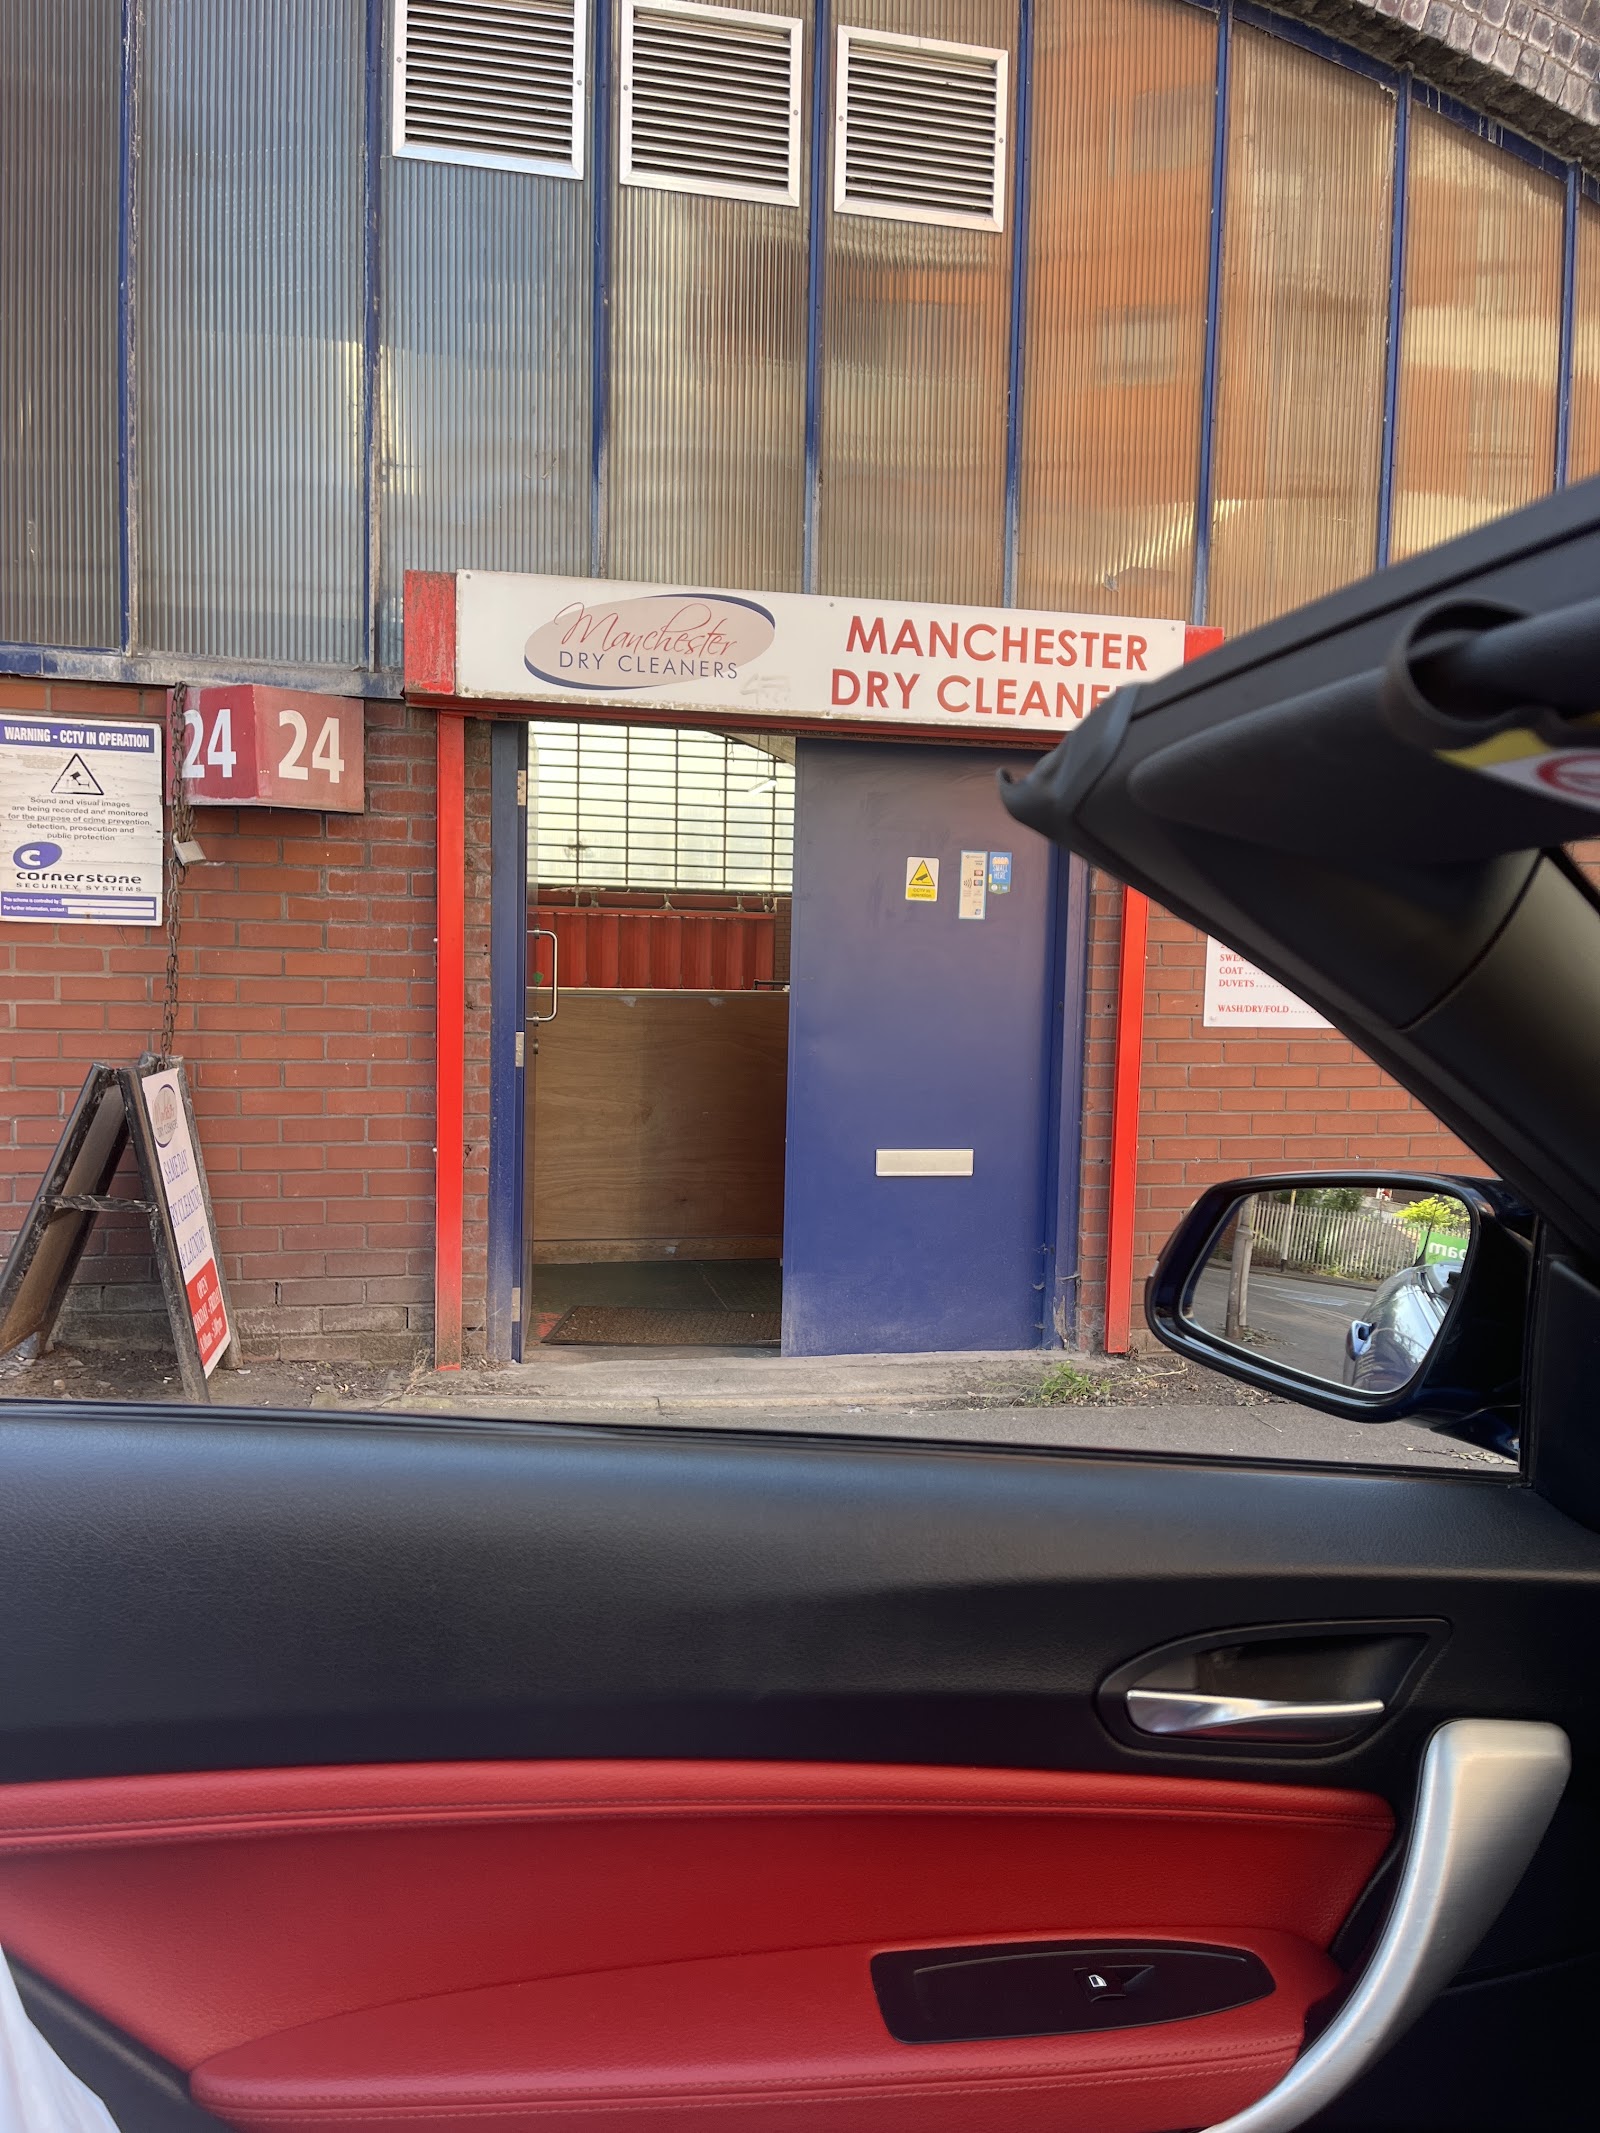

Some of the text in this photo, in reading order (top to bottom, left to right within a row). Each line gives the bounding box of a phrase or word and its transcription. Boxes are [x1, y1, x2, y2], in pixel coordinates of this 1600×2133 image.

[554, 602, 738, 657] Manchester
[846, 615, 1148, 671] MANCHESTER
[559, 651, 738, 679] DRY CLEANERS
[831, 668, 920, 709] DRY
[937, 675, 1124, 720] CLEANE
[4, 726, 51, 742] WARNING
[60, 730, 84, 744] CCTV
[86, 731, 97, 745] IN
[99, 733, 150, 748] OPERATION
[182, 709, 237, 778] 24
[278, 709, 345, 784] 24
[30, 797, 57, 805] Sound
[76, 799, 100, 807] visual
[101, 800, 131, 809] images
[27, 804, 50, 814] being
[52, 807, 89, 815] recorded
[8, 812, 20, 820] for
[37, 815, 71, 824] purpose
[69, 825, 118, 834] prosecution
[46, 832, 115, 841] public protection
[16, 871, 142, 884] cornerstone
[16, 882, 79, 890] SECURITY
[1220, 954, 1247, 962] SWEA
[1219, 967, 1244, 975] COAT
[1218, 979, 1255, 987] DUVETS
[1218, 1005, 1290, 1013] WASH/DRY/FOLD
[163, 1149, 189, 1184] SAME DAY
[169, 1203, 180, 1228] RY
